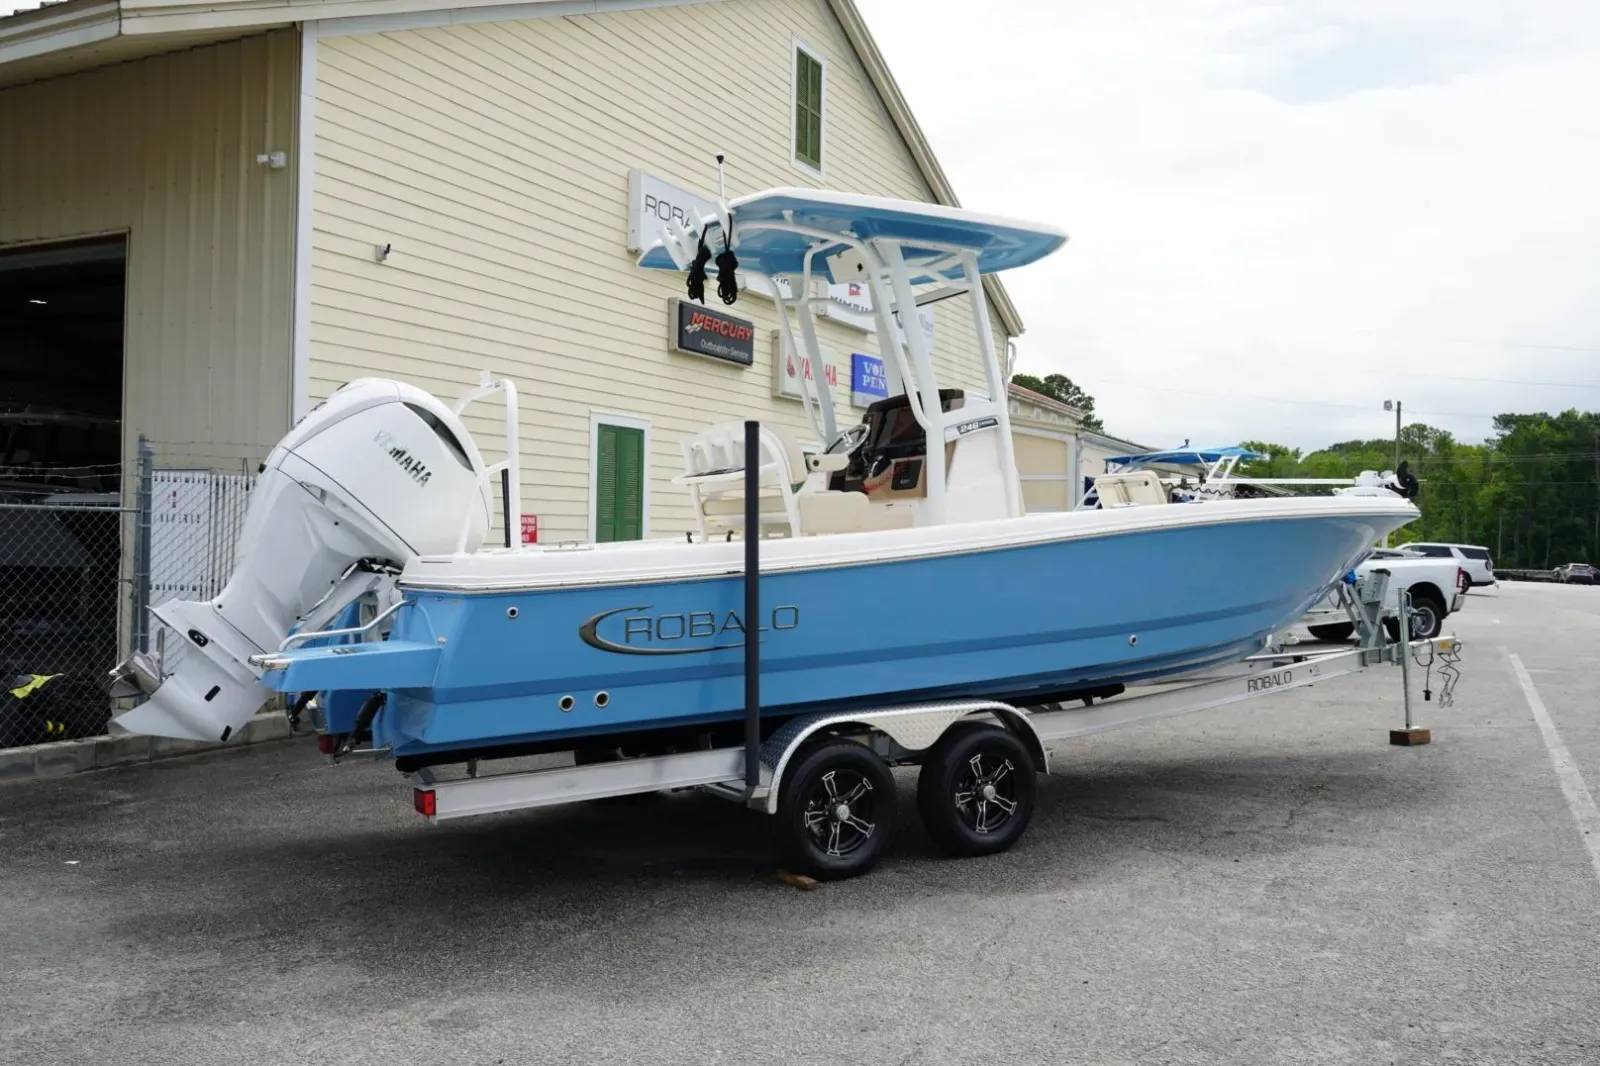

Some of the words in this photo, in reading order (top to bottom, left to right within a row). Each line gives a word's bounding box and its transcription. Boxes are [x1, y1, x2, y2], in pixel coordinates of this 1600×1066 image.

[645, 194, 691, 229] ROB
[690, 312, 752, 341] MERCURY
[730, 347, 749, 359] Service
[799, 356, 837, 387] YAHA
[863, 361, 886, 379] VOL
[862, 374, 887, 390] PEN
[960, 421, 979, 433] 246
[624, 605, 799, 644] ROBAO
[1247, 670, 1292, 693] ROBALO
